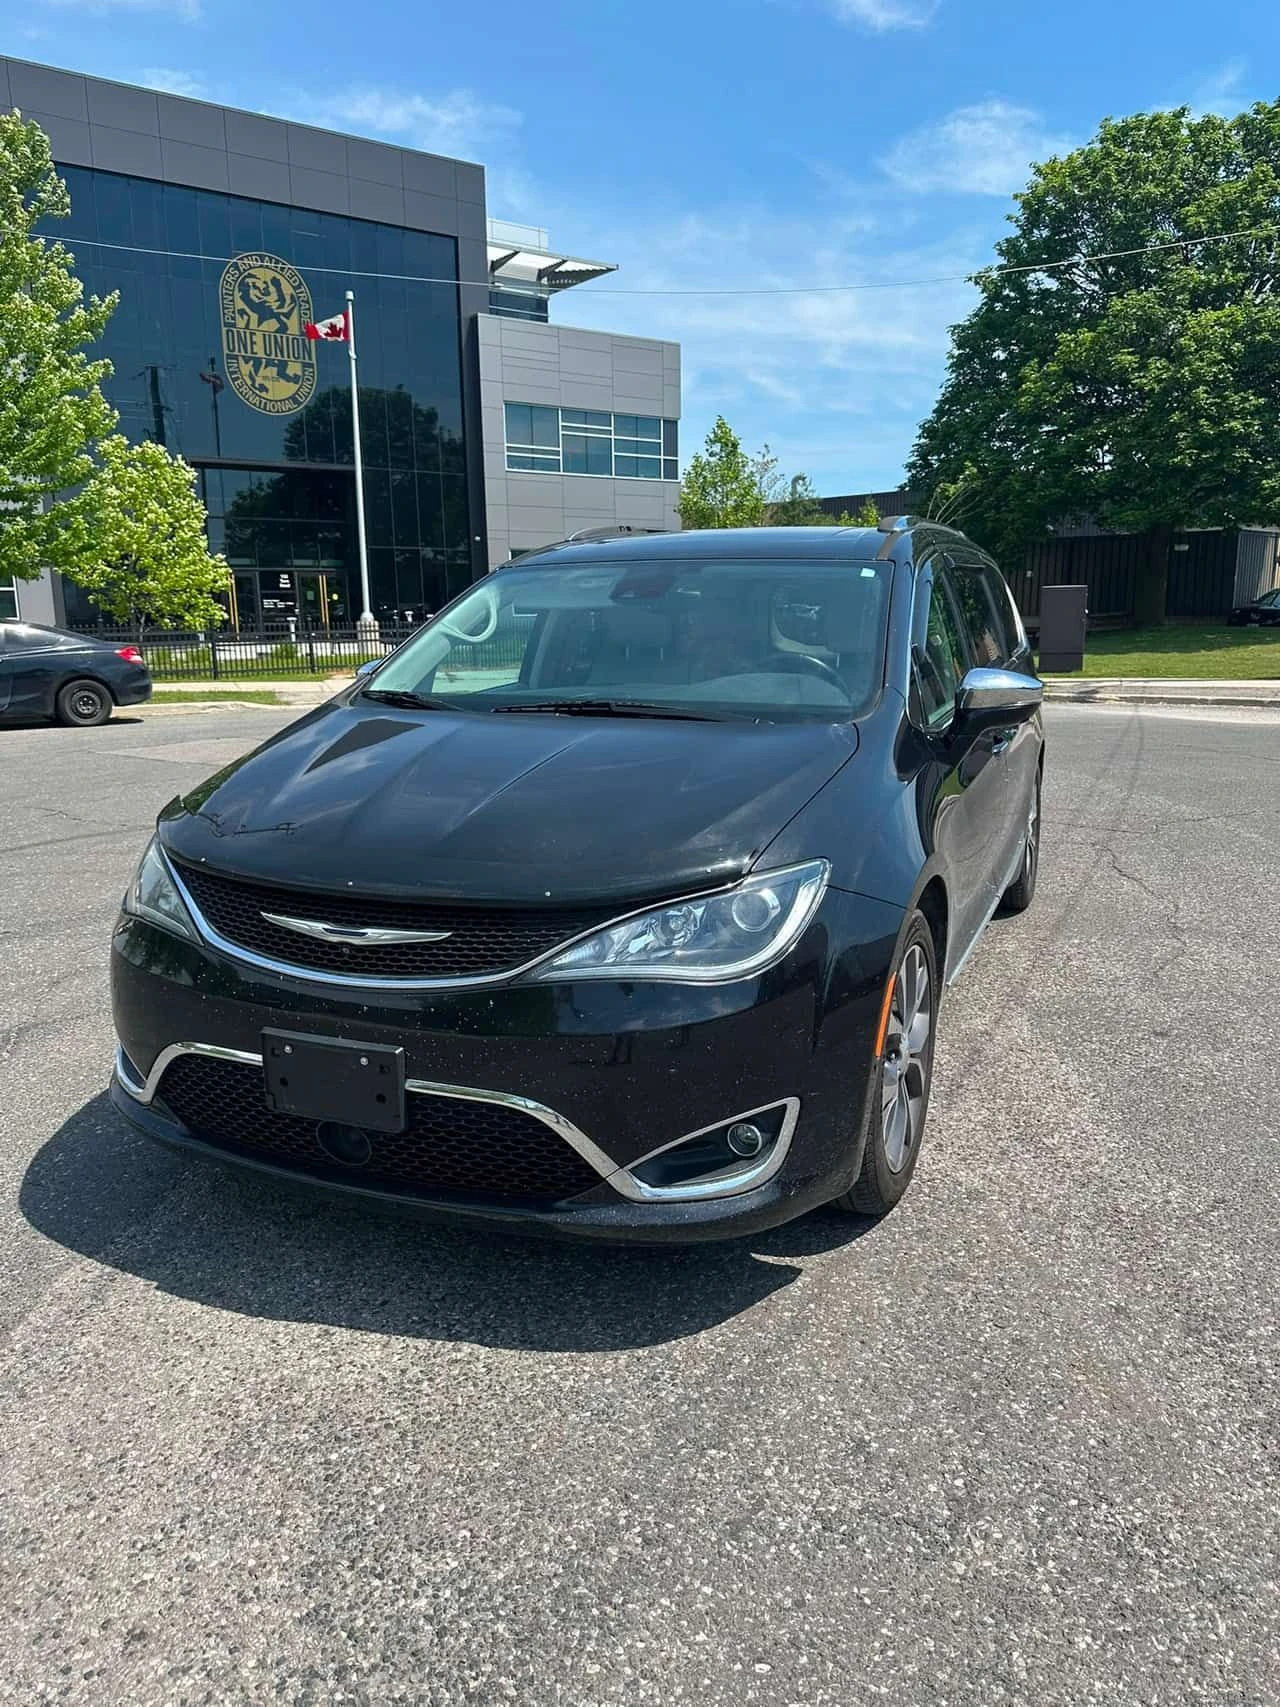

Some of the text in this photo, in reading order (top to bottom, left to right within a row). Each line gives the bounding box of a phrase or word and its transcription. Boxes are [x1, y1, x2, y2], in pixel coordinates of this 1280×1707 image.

[222, 255, 311, 331] PAINTERS AND ALLIED TRADE
[226, 328, 312, 362] ONE UNION
[227, 359, 314, 412] INTERNATIONAL UNION
